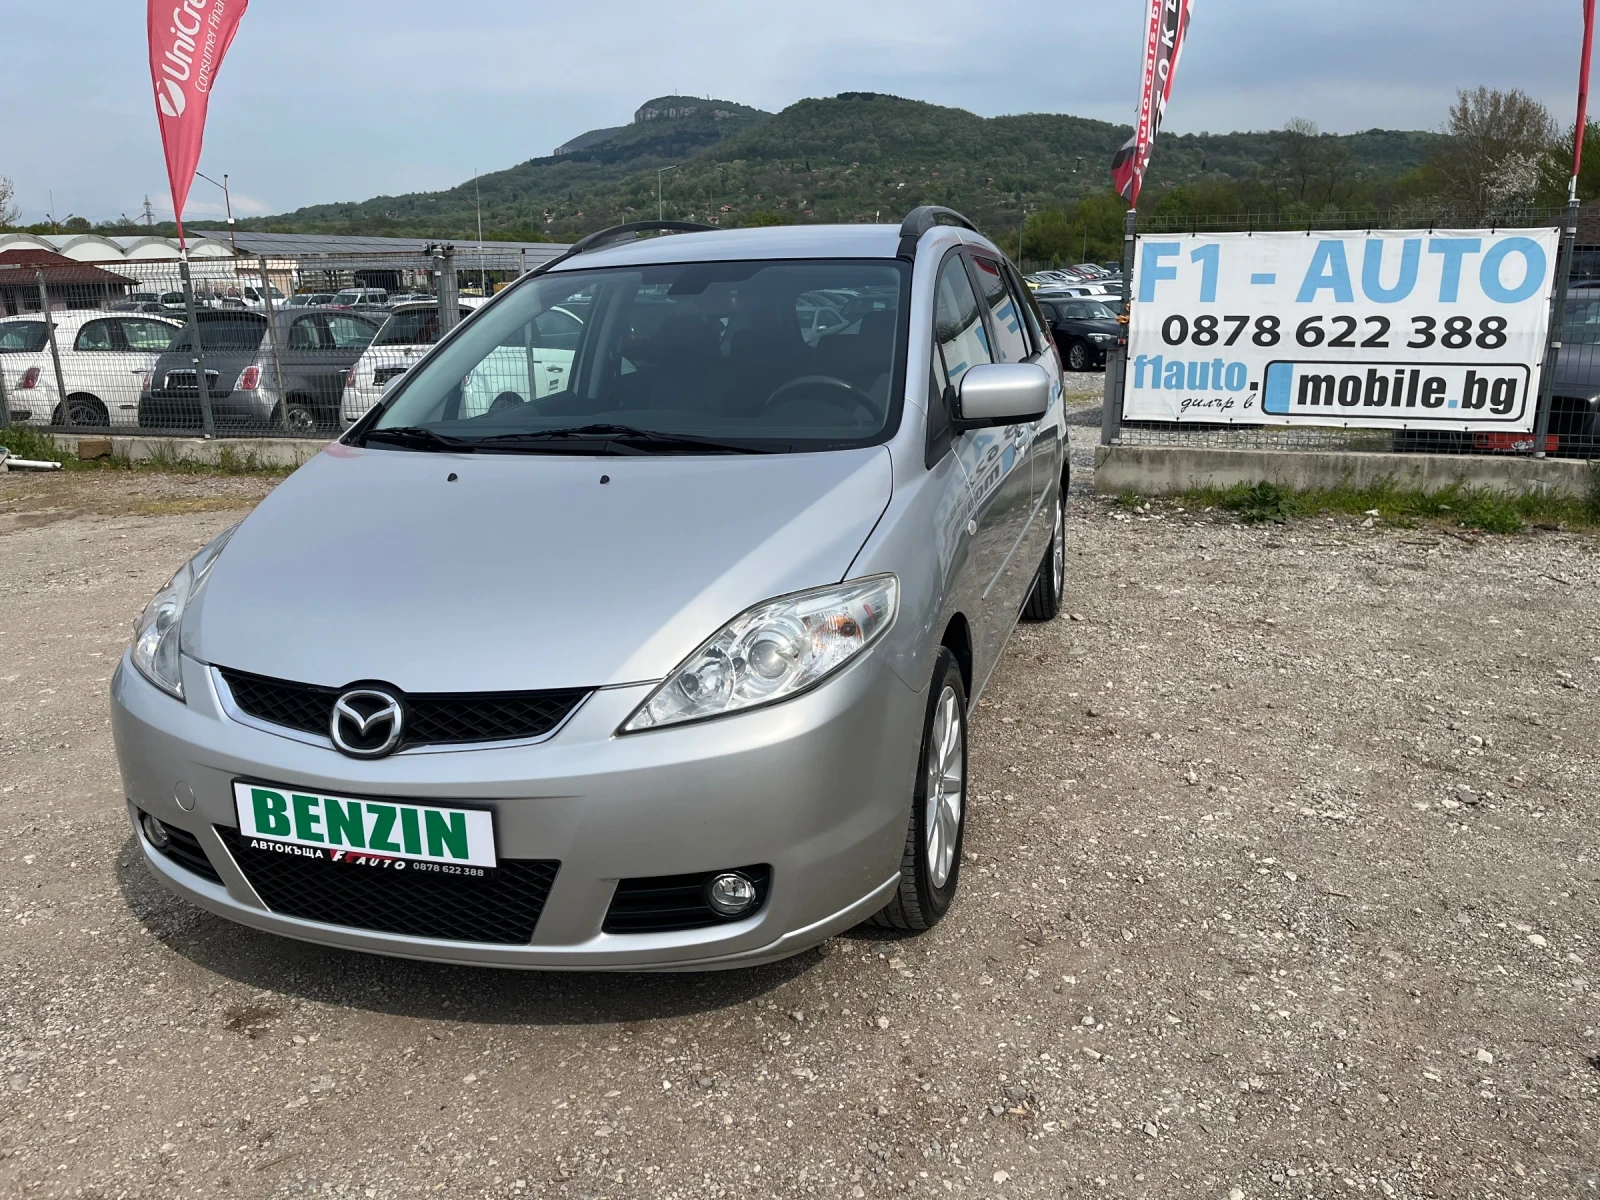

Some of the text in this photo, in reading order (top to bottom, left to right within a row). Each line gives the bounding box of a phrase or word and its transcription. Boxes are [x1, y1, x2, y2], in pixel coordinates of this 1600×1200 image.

[195, 0, 227, 93] Consumer Fina
[1138, 236, 1547, 304] F1 - AUTO
[1161, 314, 1508, 350] 0878 622 388
[1133, 354, 1518, 415] f1auto. mobile.bg
[1180, 397, 1236, 413] дилър
[251, 788, 469, 860] BENZIN
[250, 839, 324, 859] АВТОКЪЩА
[355, 856, 406, 870] AUTO
[413, 862, 440, 872] 0878
[442, 865, 462, 875] 622
[463, 867, 484, 877] 388
